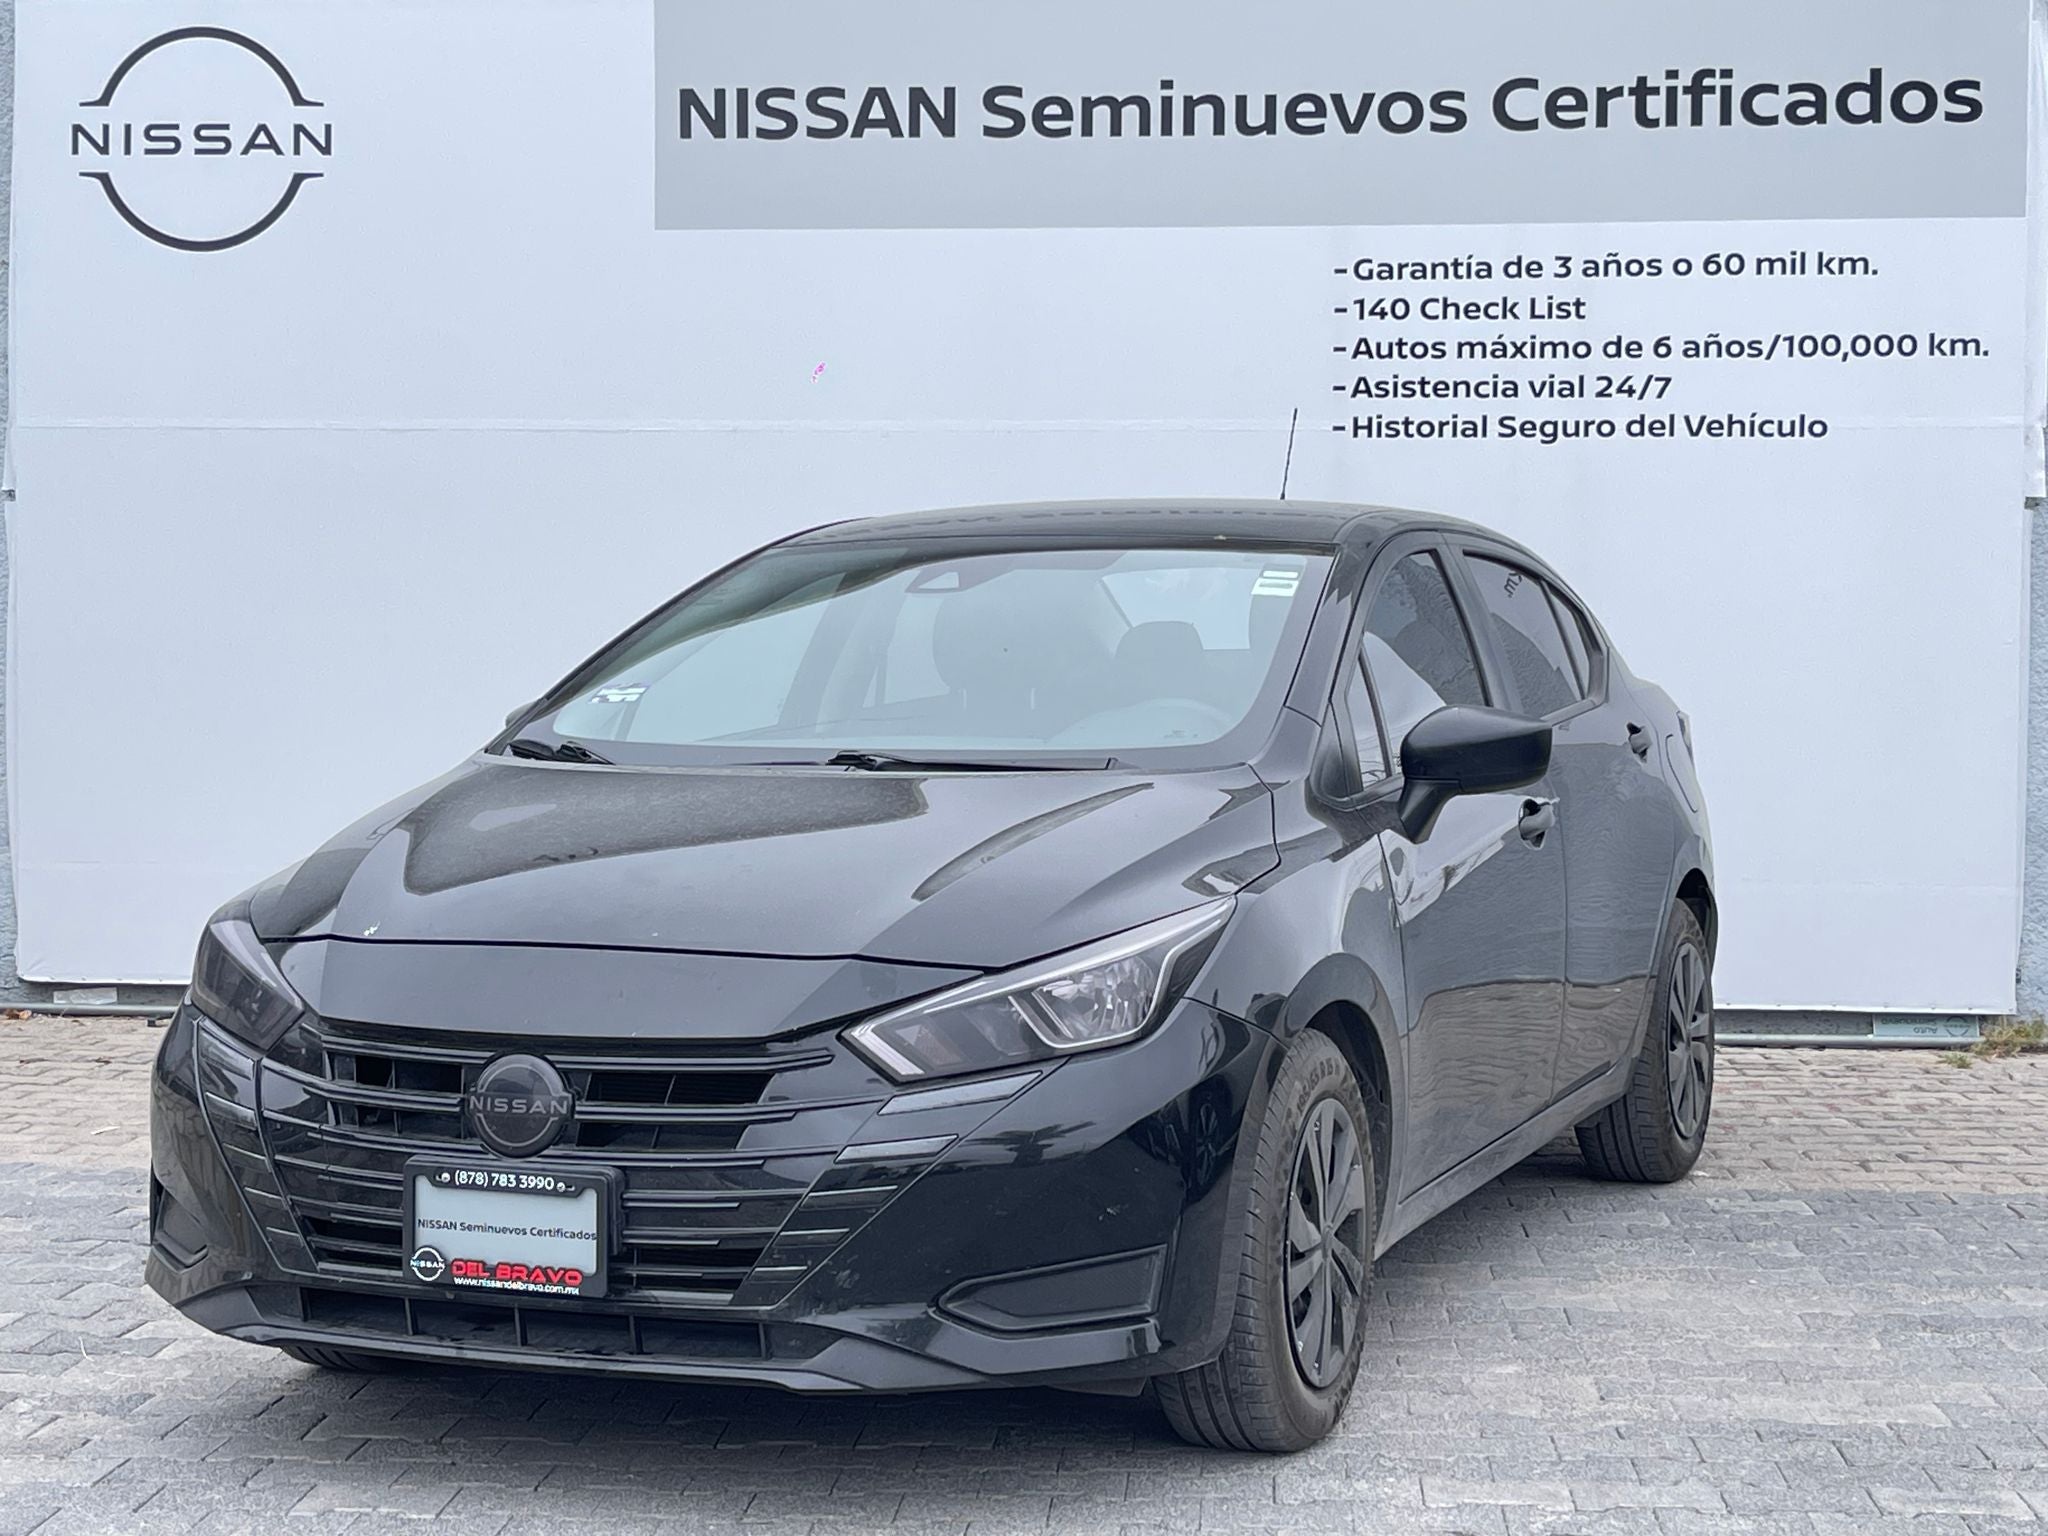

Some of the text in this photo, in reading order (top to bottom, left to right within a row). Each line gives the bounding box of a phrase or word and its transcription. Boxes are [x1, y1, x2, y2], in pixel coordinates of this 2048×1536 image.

[680, 67, 1983, 140] NISSAN Seminuevos Certificados
[71, 123, 333, 156] NISSAN
[1502, 255, 1544, 279] de
[1553, 255, 1572, 279] 3
[1581, 252, 1663, 278] años
[1672, 258, 1693, 276] o
[1702, 253, 1745, 276] 60
[1755, 250, 1806, 276] mil
[1817, 251, 1878, 276] km.
[1420, 296, 1520, 320] Check
[1529, 295, 1586, 320] List
[1456, 333, 1592, 359] máximo
[1602, 335, 1643, 359] de
[1653, 335, 1672, 359] 6
[1682, 333, 1918, 363] años/100,000
[1929, 332, 1989, 357] km.
[1528, 373, 1585, 399] vial
[1595, 374, 1672, 401] 24/7
[1498, 415, 1616, 445] Seguro
[1625, 413, 1675, 438] del
[1683, 412, 1828, 438] Vehículo
[469, 1095, 568, 1114] NISSAN
[454, 1169, 555, 1190] (878) 783 3990
[417, 1218, 598, 1241] NISSAN Seminuevos Certificados
[451, 1259, 583, 1286] DEL BRAVO
